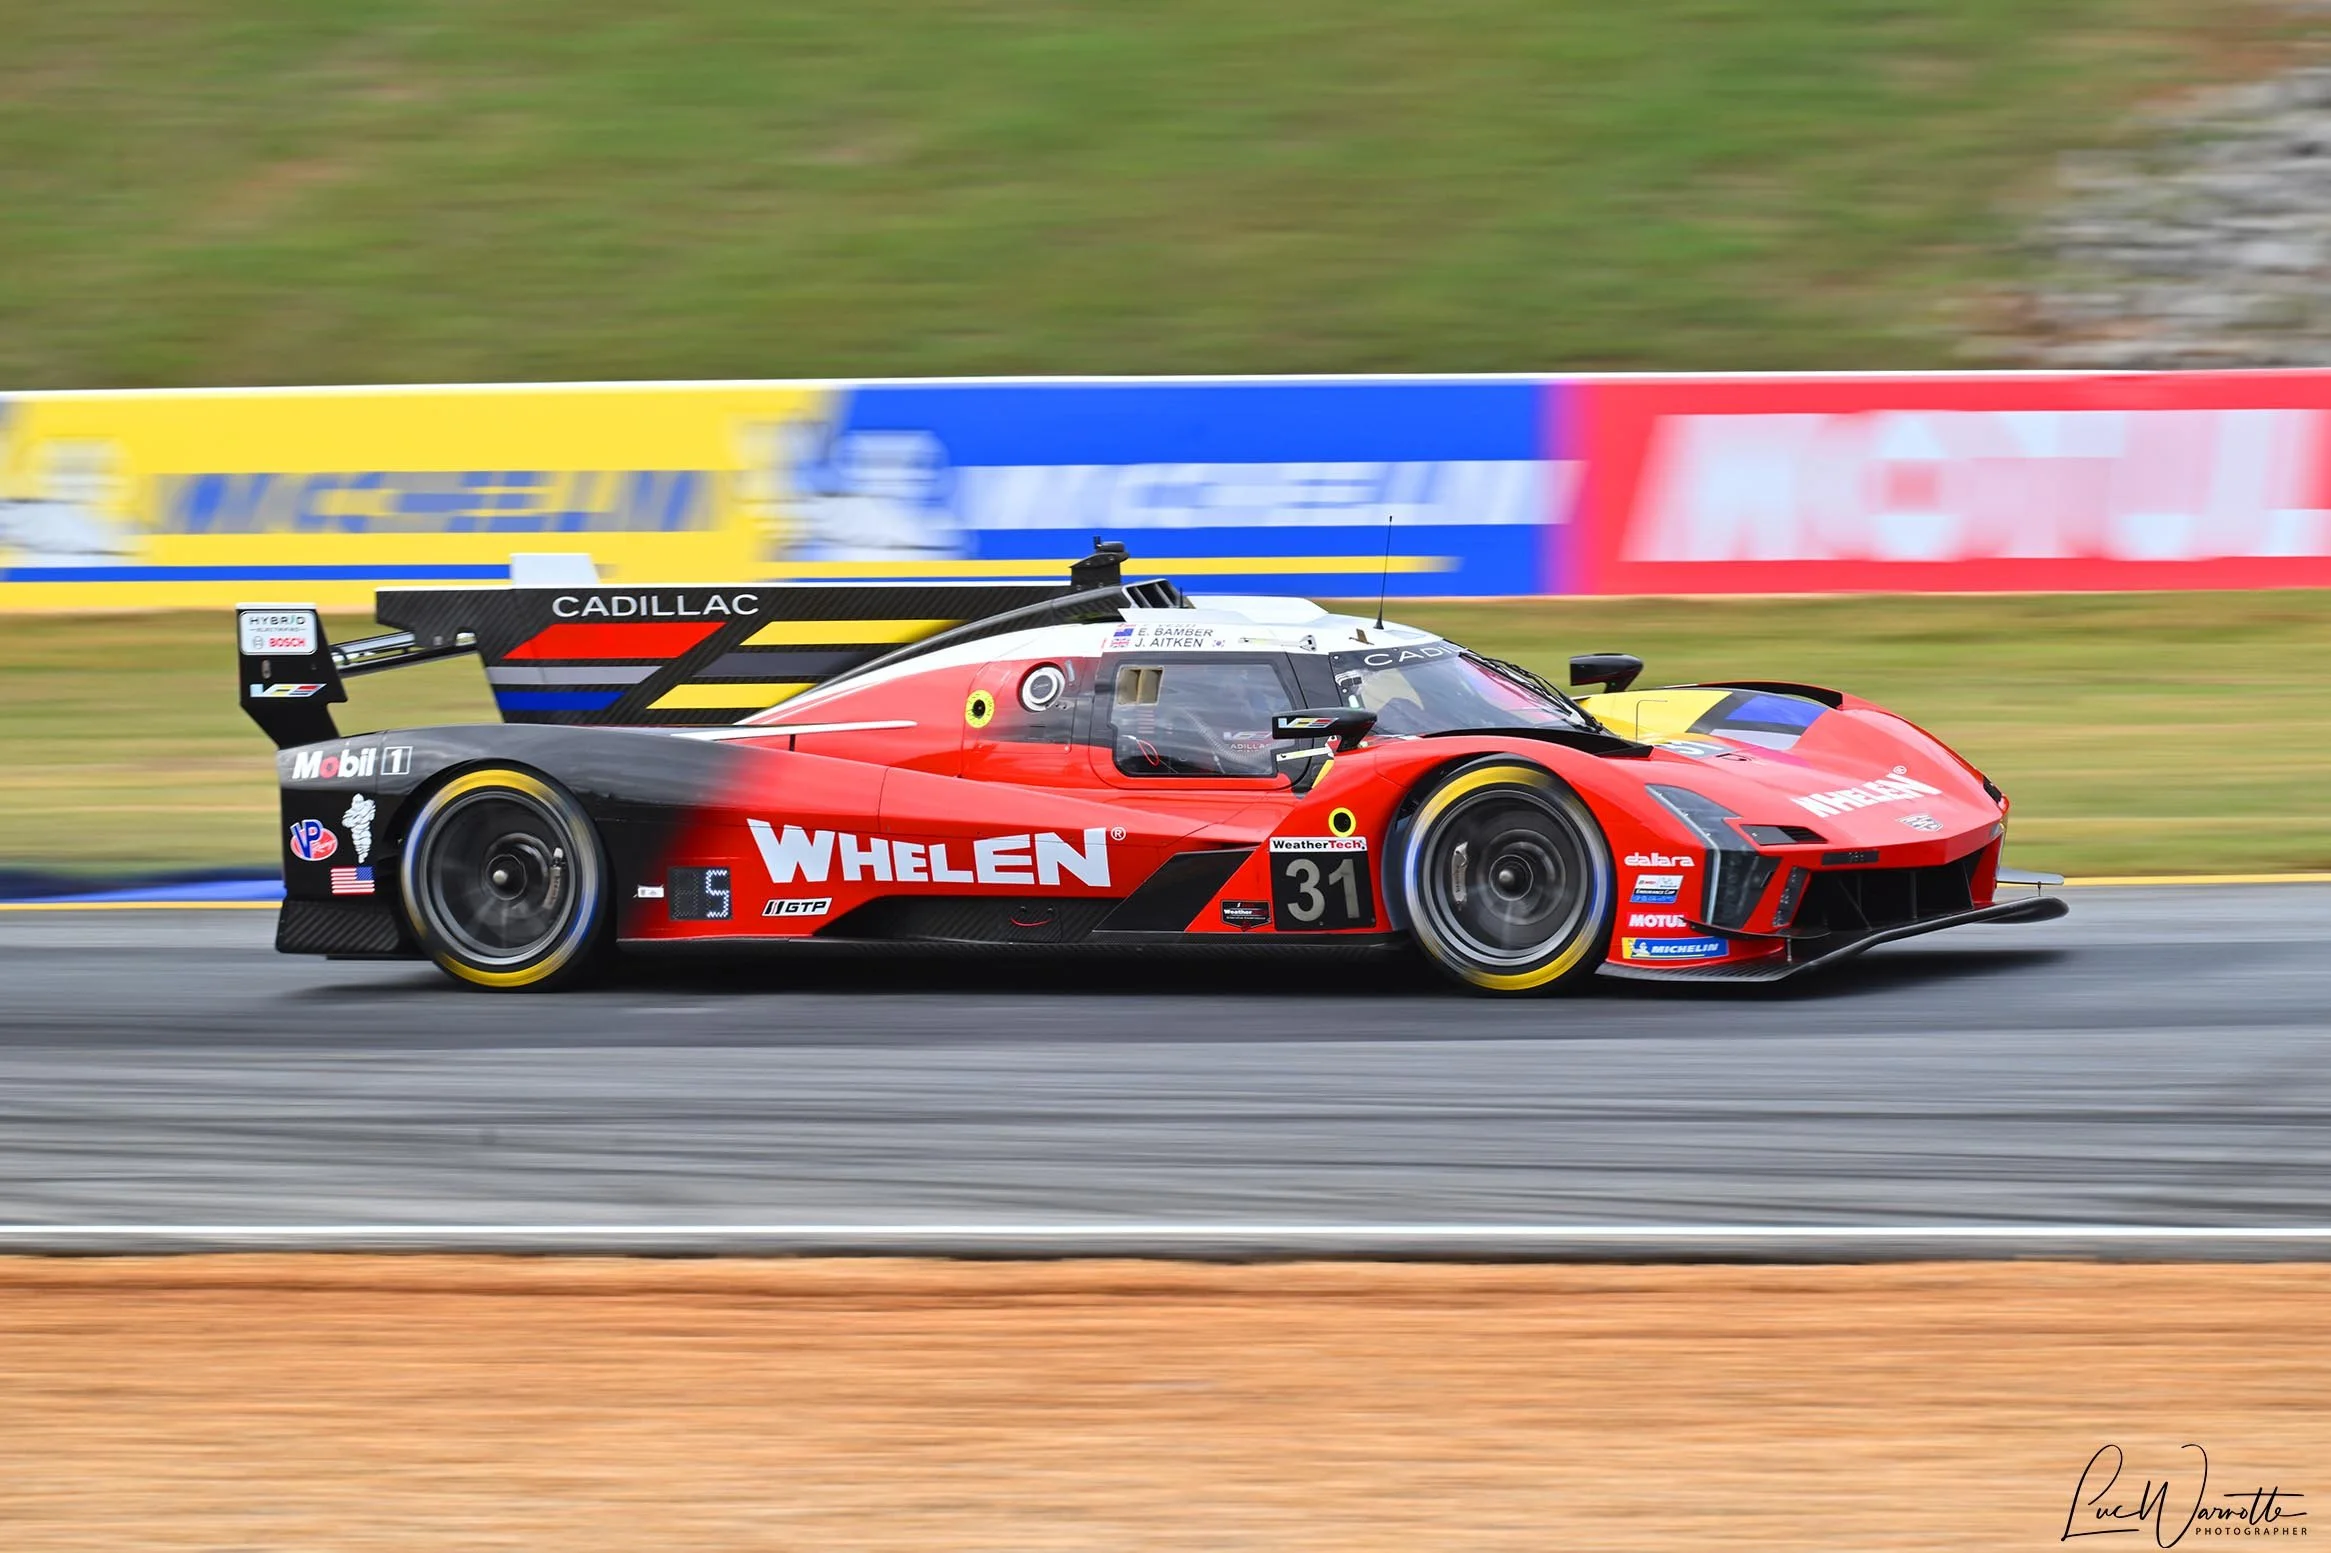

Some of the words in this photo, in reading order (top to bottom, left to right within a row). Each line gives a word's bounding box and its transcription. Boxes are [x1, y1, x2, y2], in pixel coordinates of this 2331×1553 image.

[551, 593, 760, 618] CADILLAC
[249, 615, 306, 625] HYBRID
[1138, 627, 1149, 636] E.
[1154, 628, 1214, 637] BAMBER
[269, 637, 306, 648] BOSCH
[1134, 638, 1146, 648] J.
[1150, 638, 1204, 648] AITKEN
[292, 747, 377, 780] Mobil
[289, 819, 323, 860] VP
[1624, 852, 1695, 867] dallara
[1285, 858, 1361, 922] 31
[784, 901, 827, 913] GTP
[1651, 943, 1719, 954] MICHELIN
